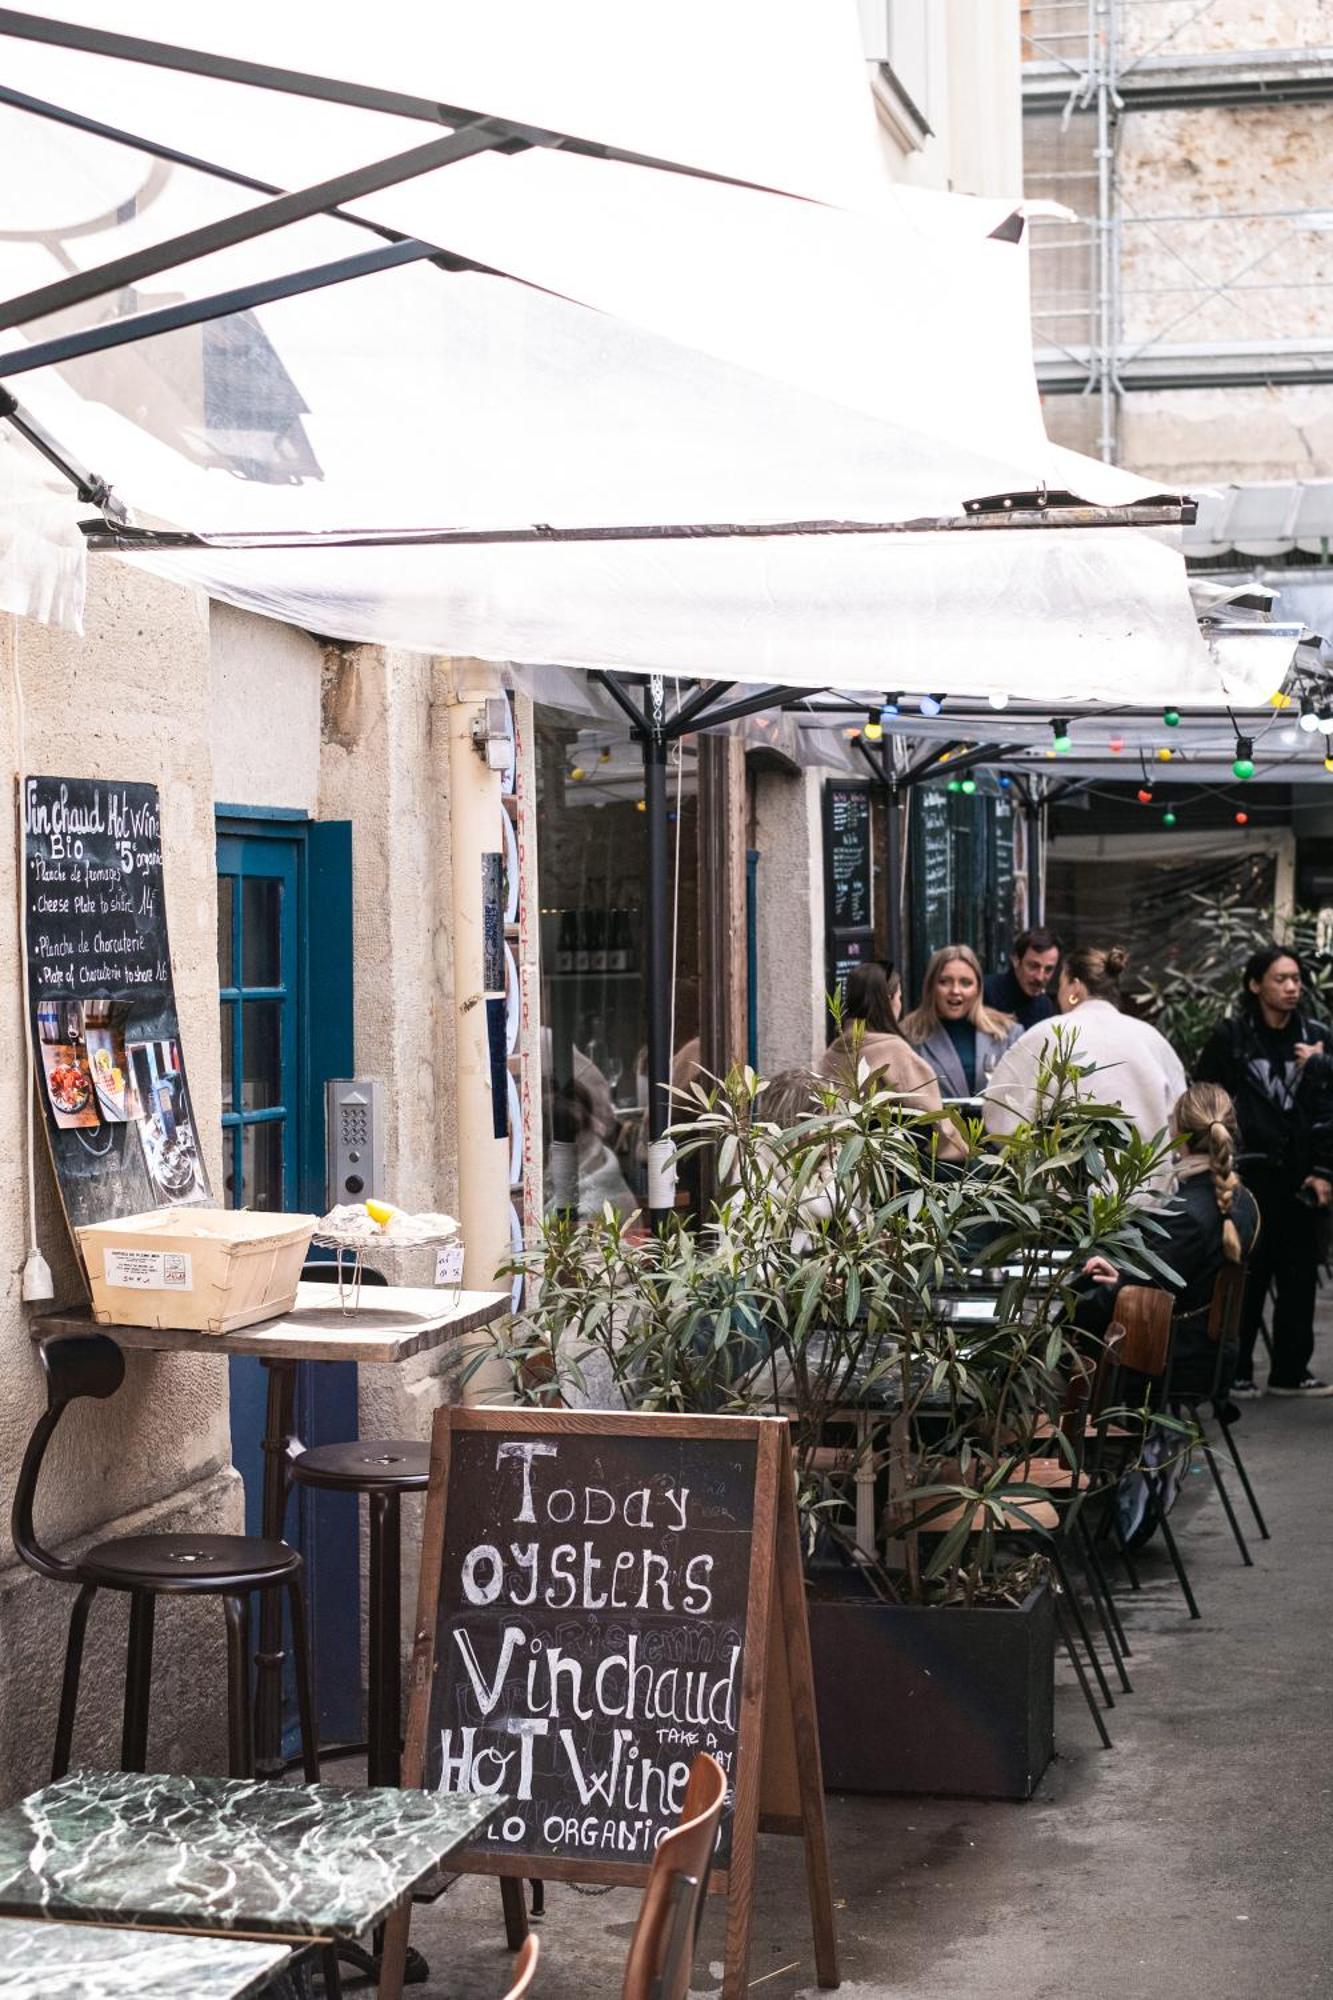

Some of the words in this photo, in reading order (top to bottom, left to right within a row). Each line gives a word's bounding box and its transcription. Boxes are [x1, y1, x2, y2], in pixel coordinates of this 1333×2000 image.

[50, 834, 84, 860] Bio
[35, 852, 66, 882] Planche
[70, 864, 81, 883] de
[83, 859, 122, 892] fromages
[37, 893, 69, 913] Cheese
[39, 933, 75, 958] Planche
[78, 930, 90, 953] de
[65, 962, 75, 990] of
[656, 1727, 699, 1747] TAKE
[706, 1732, 718, 1749] A
[559, 1728, 691, 1816] Wine
[711, 1750, 732, 1773] AY
